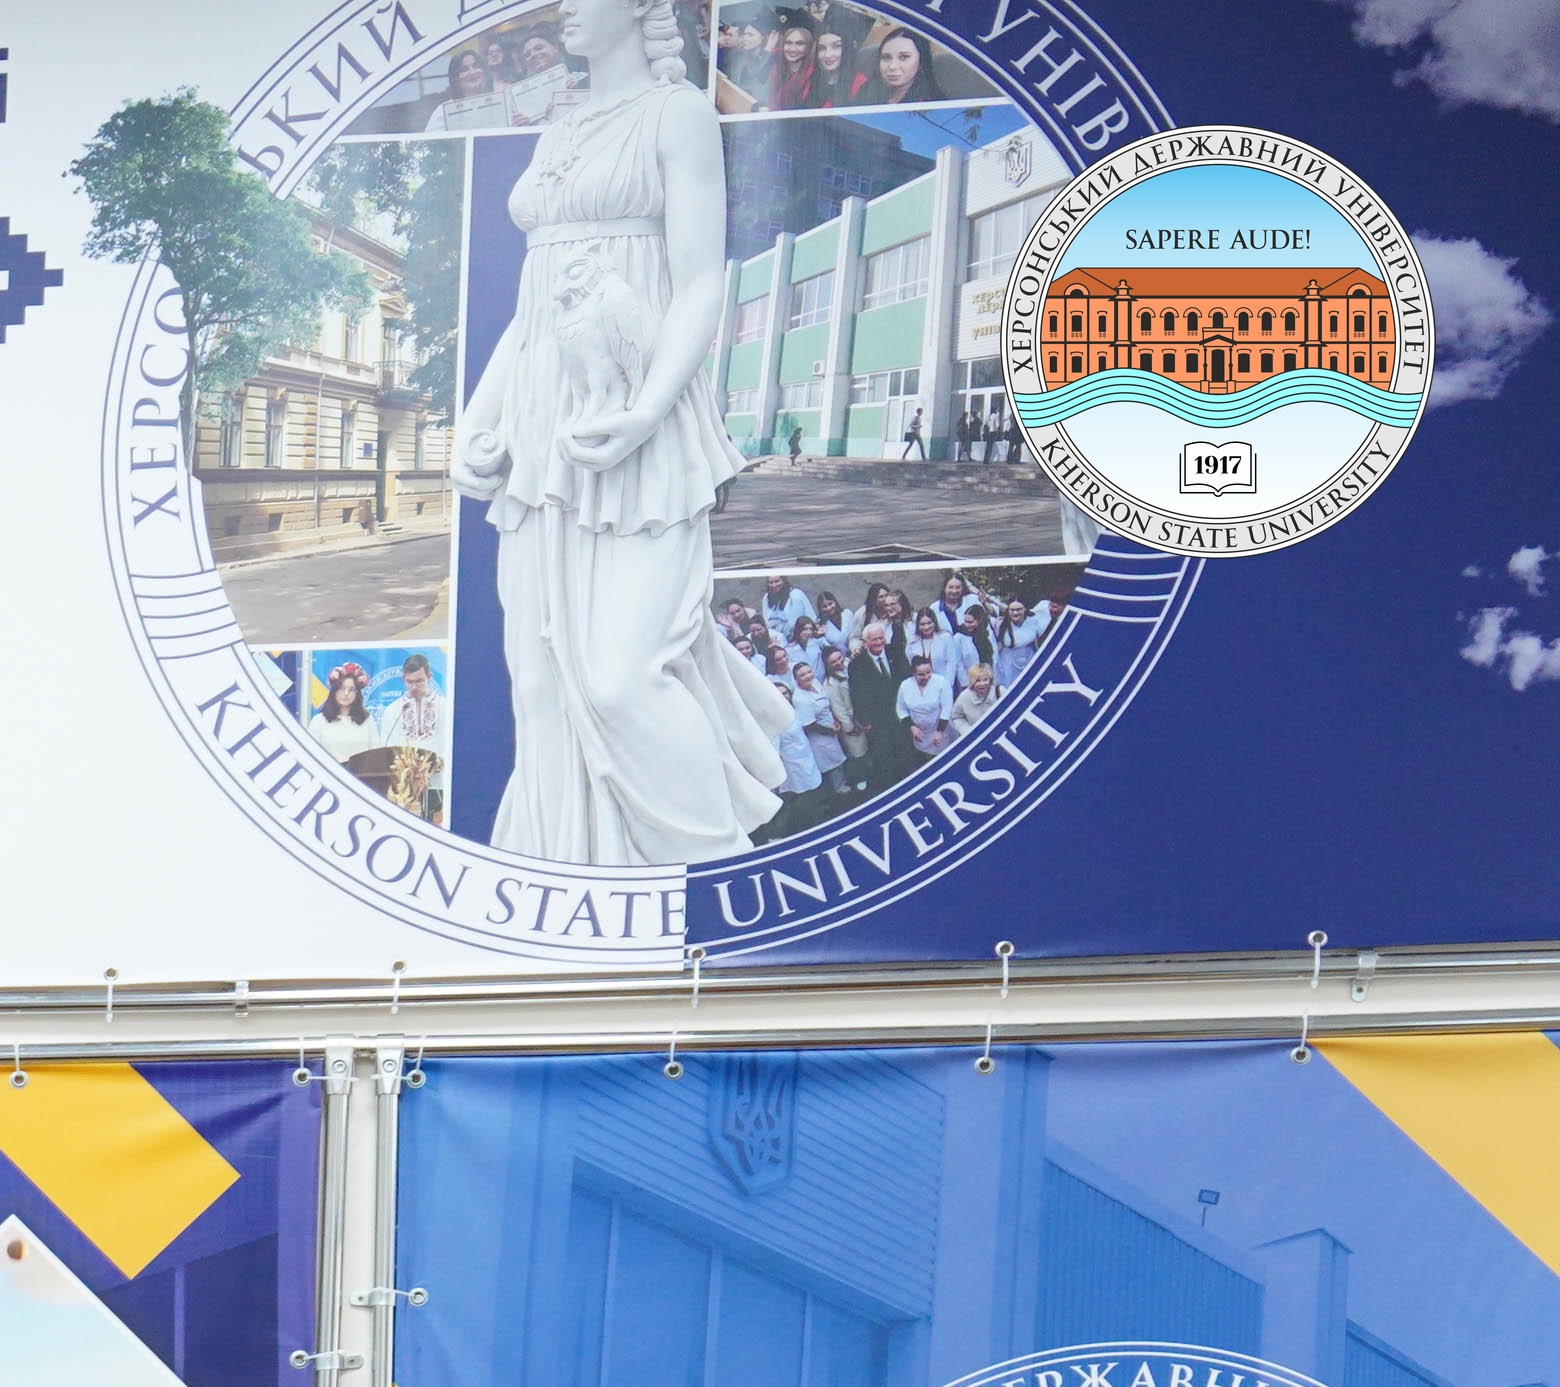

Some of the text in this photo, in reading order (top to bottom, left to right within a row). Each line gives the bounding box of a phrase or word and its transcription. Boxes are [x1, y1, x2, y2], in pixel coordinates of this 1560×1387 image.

[131, 0, 426, 530] ХЕРСОЬКИЙ
[198, 658, 1104, 940] KHERSON STATE UNIVERSITY
